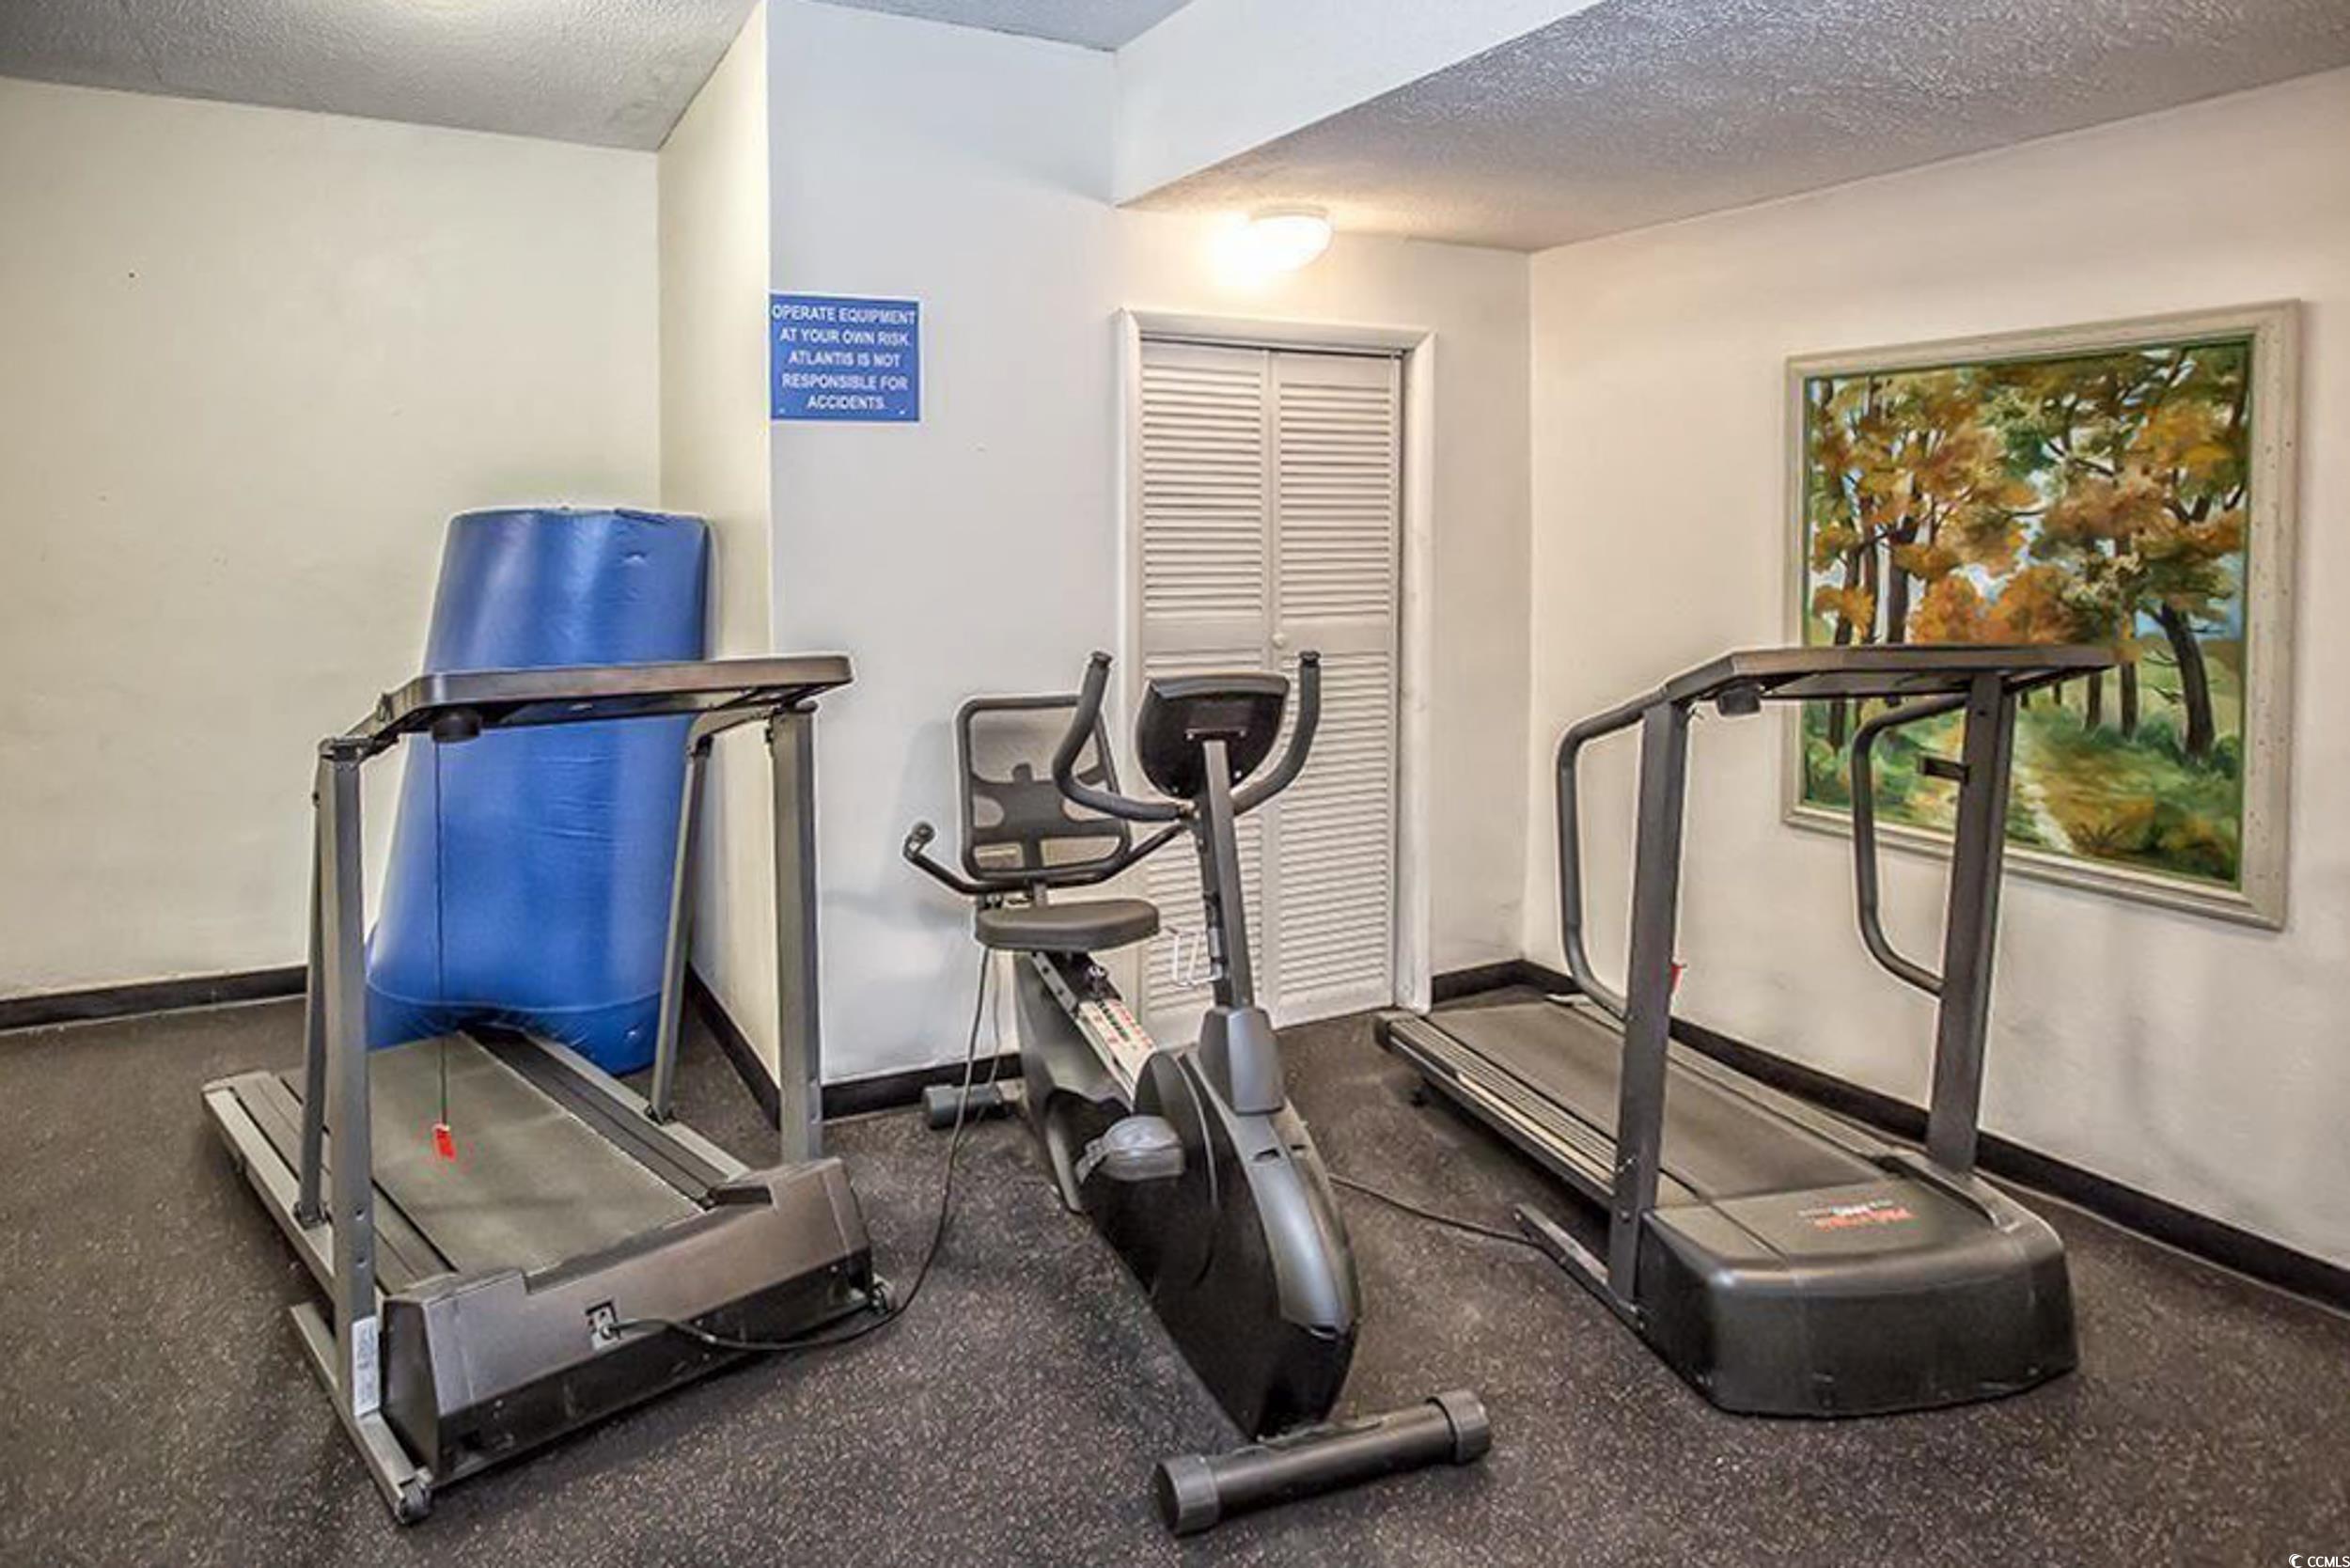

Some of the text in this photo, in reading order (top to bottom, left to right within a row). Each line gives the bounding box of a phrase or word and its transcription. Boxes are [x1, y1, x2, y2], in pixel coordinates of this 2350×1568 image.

[772, 305, 916, 324] OPERATE EQUIPMENT
[779, 329, 910, 346] AT YOUR OWN RISK
[788, 351, 901, 368] ATLANTIS IS NOT
[782, 373, 908, 390] RESPONSIBLE FOR
